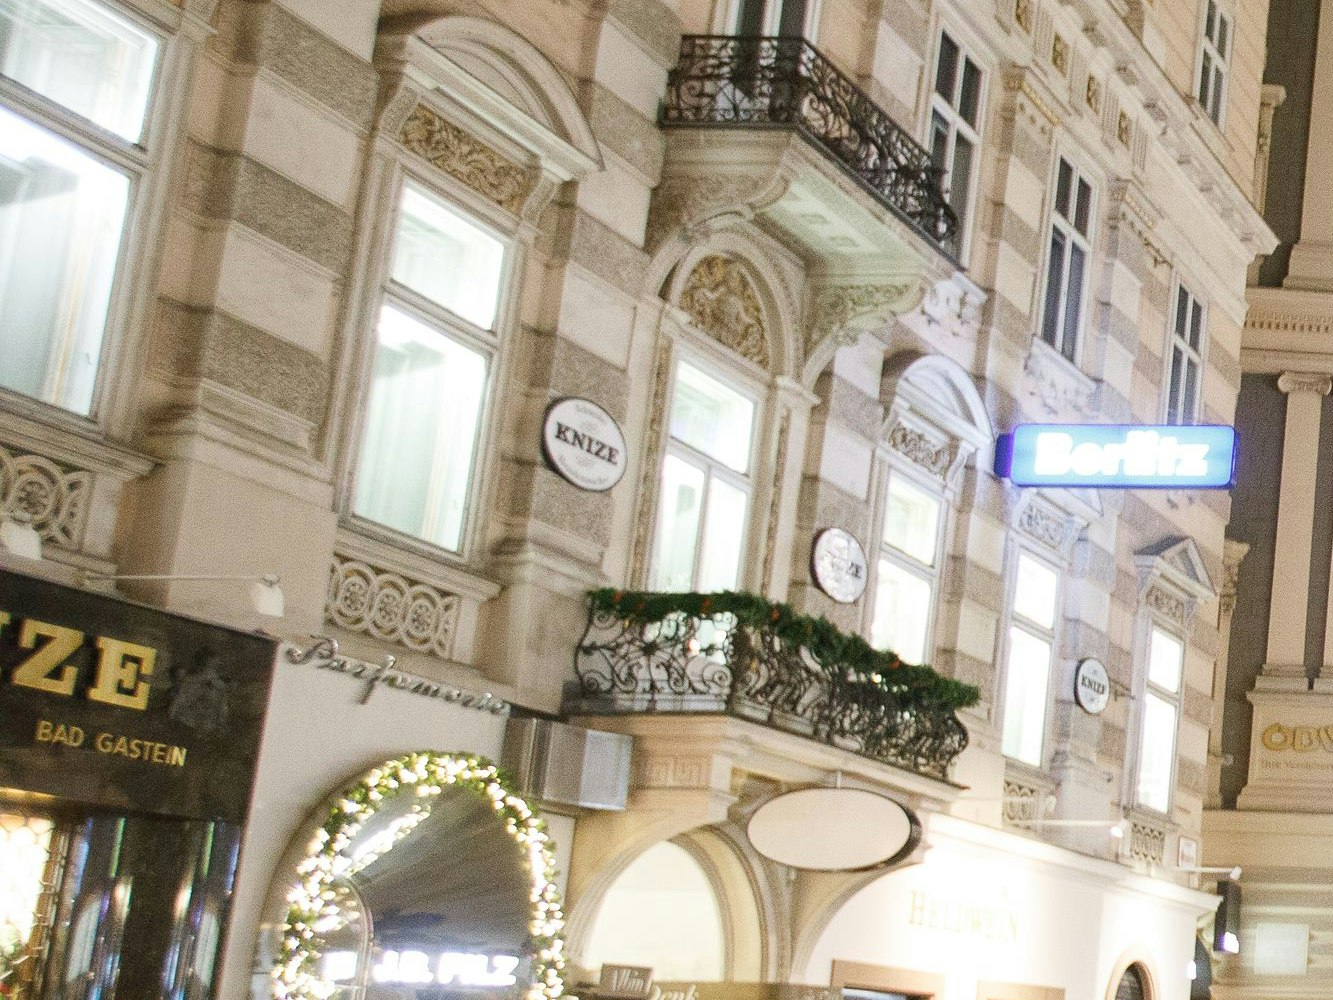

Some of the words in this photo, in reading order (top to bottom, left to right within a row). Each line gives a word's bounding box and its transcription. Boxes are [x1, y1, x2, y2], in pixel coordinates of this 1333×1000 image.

[555, 421, 619, 466] KNIZE
[1034, 430, 1210, 476] Berlitz
[0, 610, 157, 711] ZE
[35, 720, 85, 747] BAD
[96, 733, 187, 767] GASTEIN
